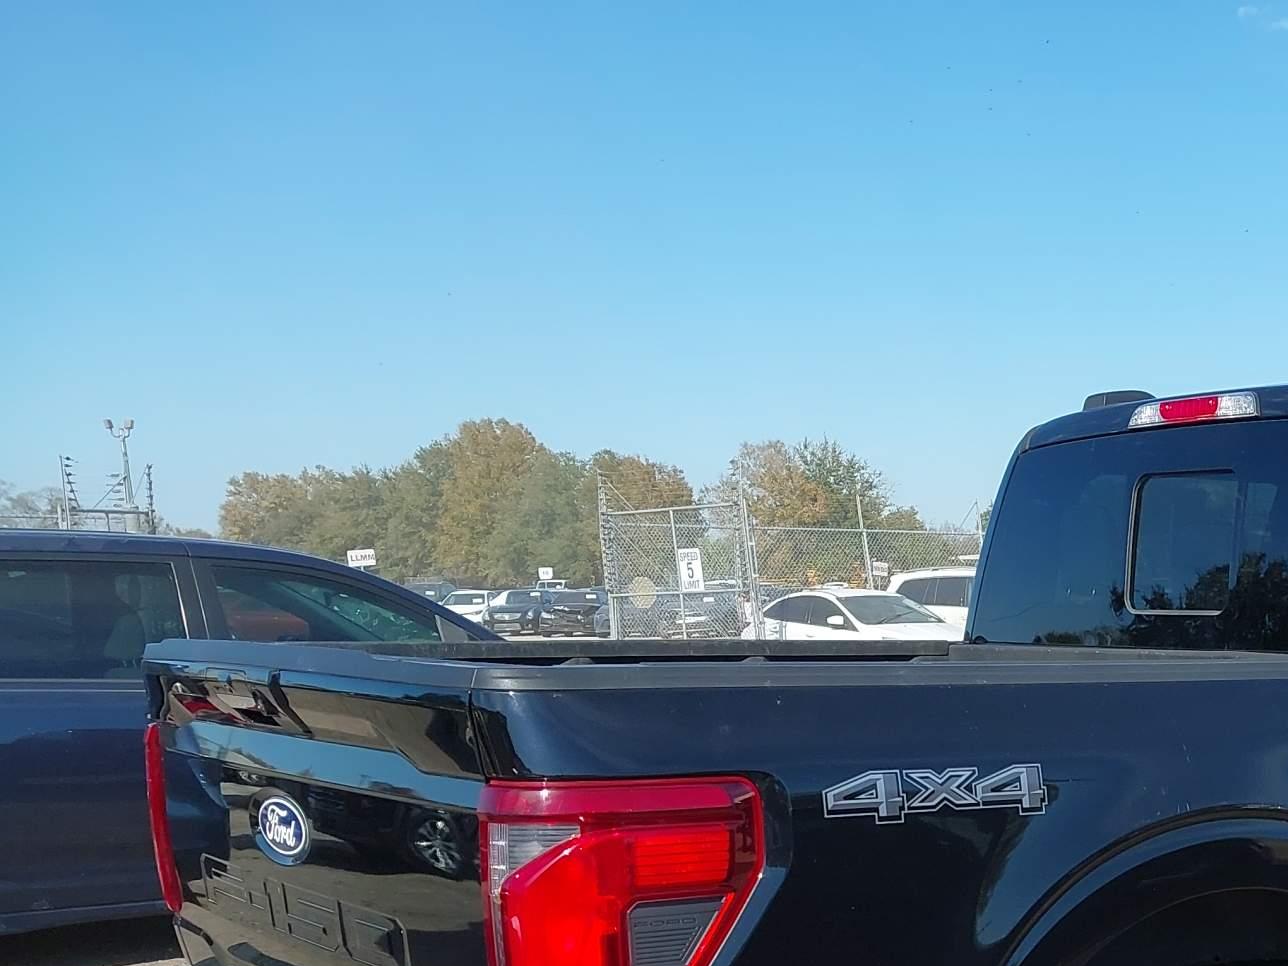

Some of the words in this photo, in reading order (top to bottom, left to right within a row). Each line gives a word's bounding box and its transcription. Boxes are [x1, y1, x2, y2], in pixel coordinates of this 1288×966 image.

[679, 551, 698, 562] SPEED
[686, 561, 694, 579] 5
[683, 580, 700, 590] LIMIT
[265, 804, 297, 848] Ford
[633, 913, 699, 929] FORD
